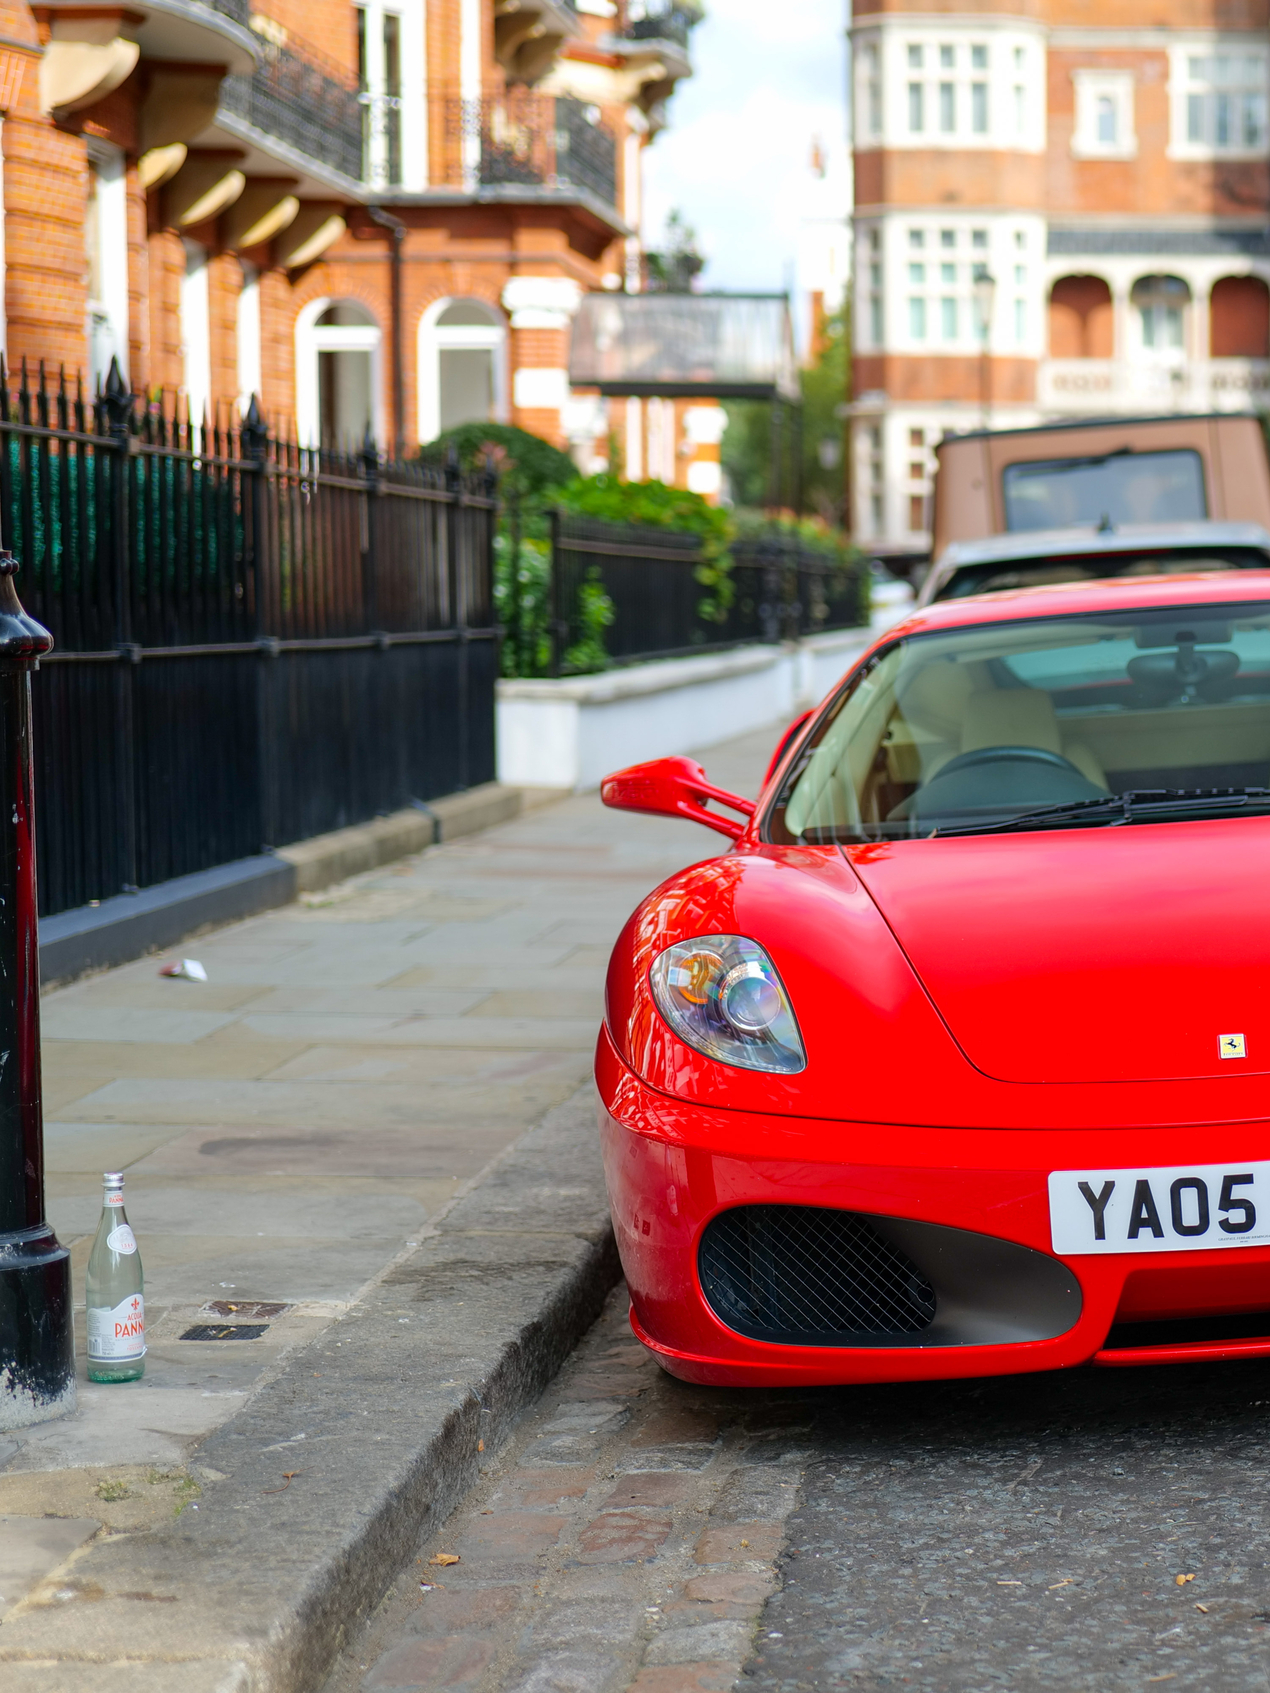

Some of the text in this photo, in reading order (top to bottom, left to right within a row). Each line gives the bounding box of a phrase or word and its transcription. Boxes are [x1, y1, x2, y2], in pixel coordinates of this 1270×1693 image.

[1077, 1173, 1256, 1241] YA05
[127, 1312, 142, 1321] ACQUA
[115, 1319, 145, 1338] PANN
